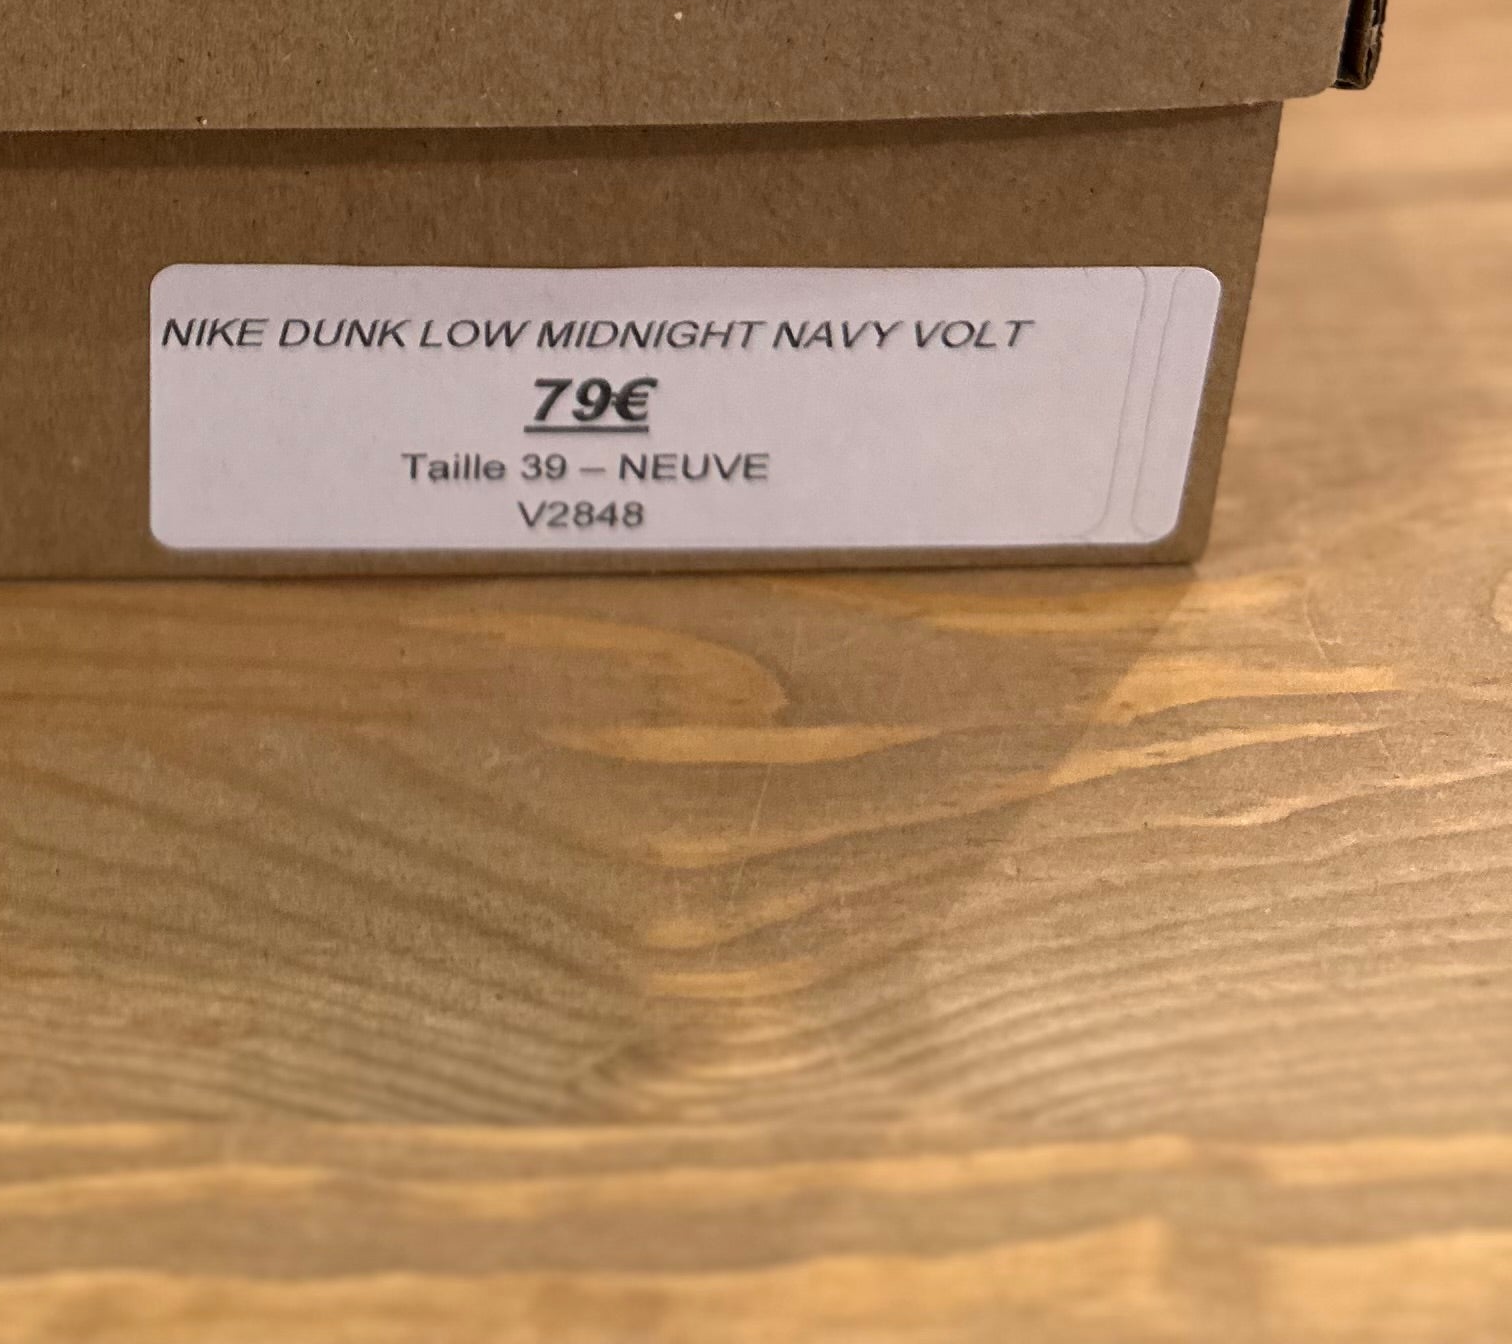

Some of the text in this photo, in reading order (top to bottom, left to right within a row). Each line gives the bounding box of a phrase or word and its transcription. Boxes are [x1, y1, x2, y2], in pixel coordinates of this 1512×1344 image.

[160, 318, 1035, 350] NIKE DUNK LOW MIDNIGHT NAVY VOLT
[531, 377, 658, 425] 79€
[401, 453, 507, 482] Taille
[521, 453, 568, 482] 39
[618, 453, 770, 482] NEUVE
[517, 501, 644, 530] V2848
